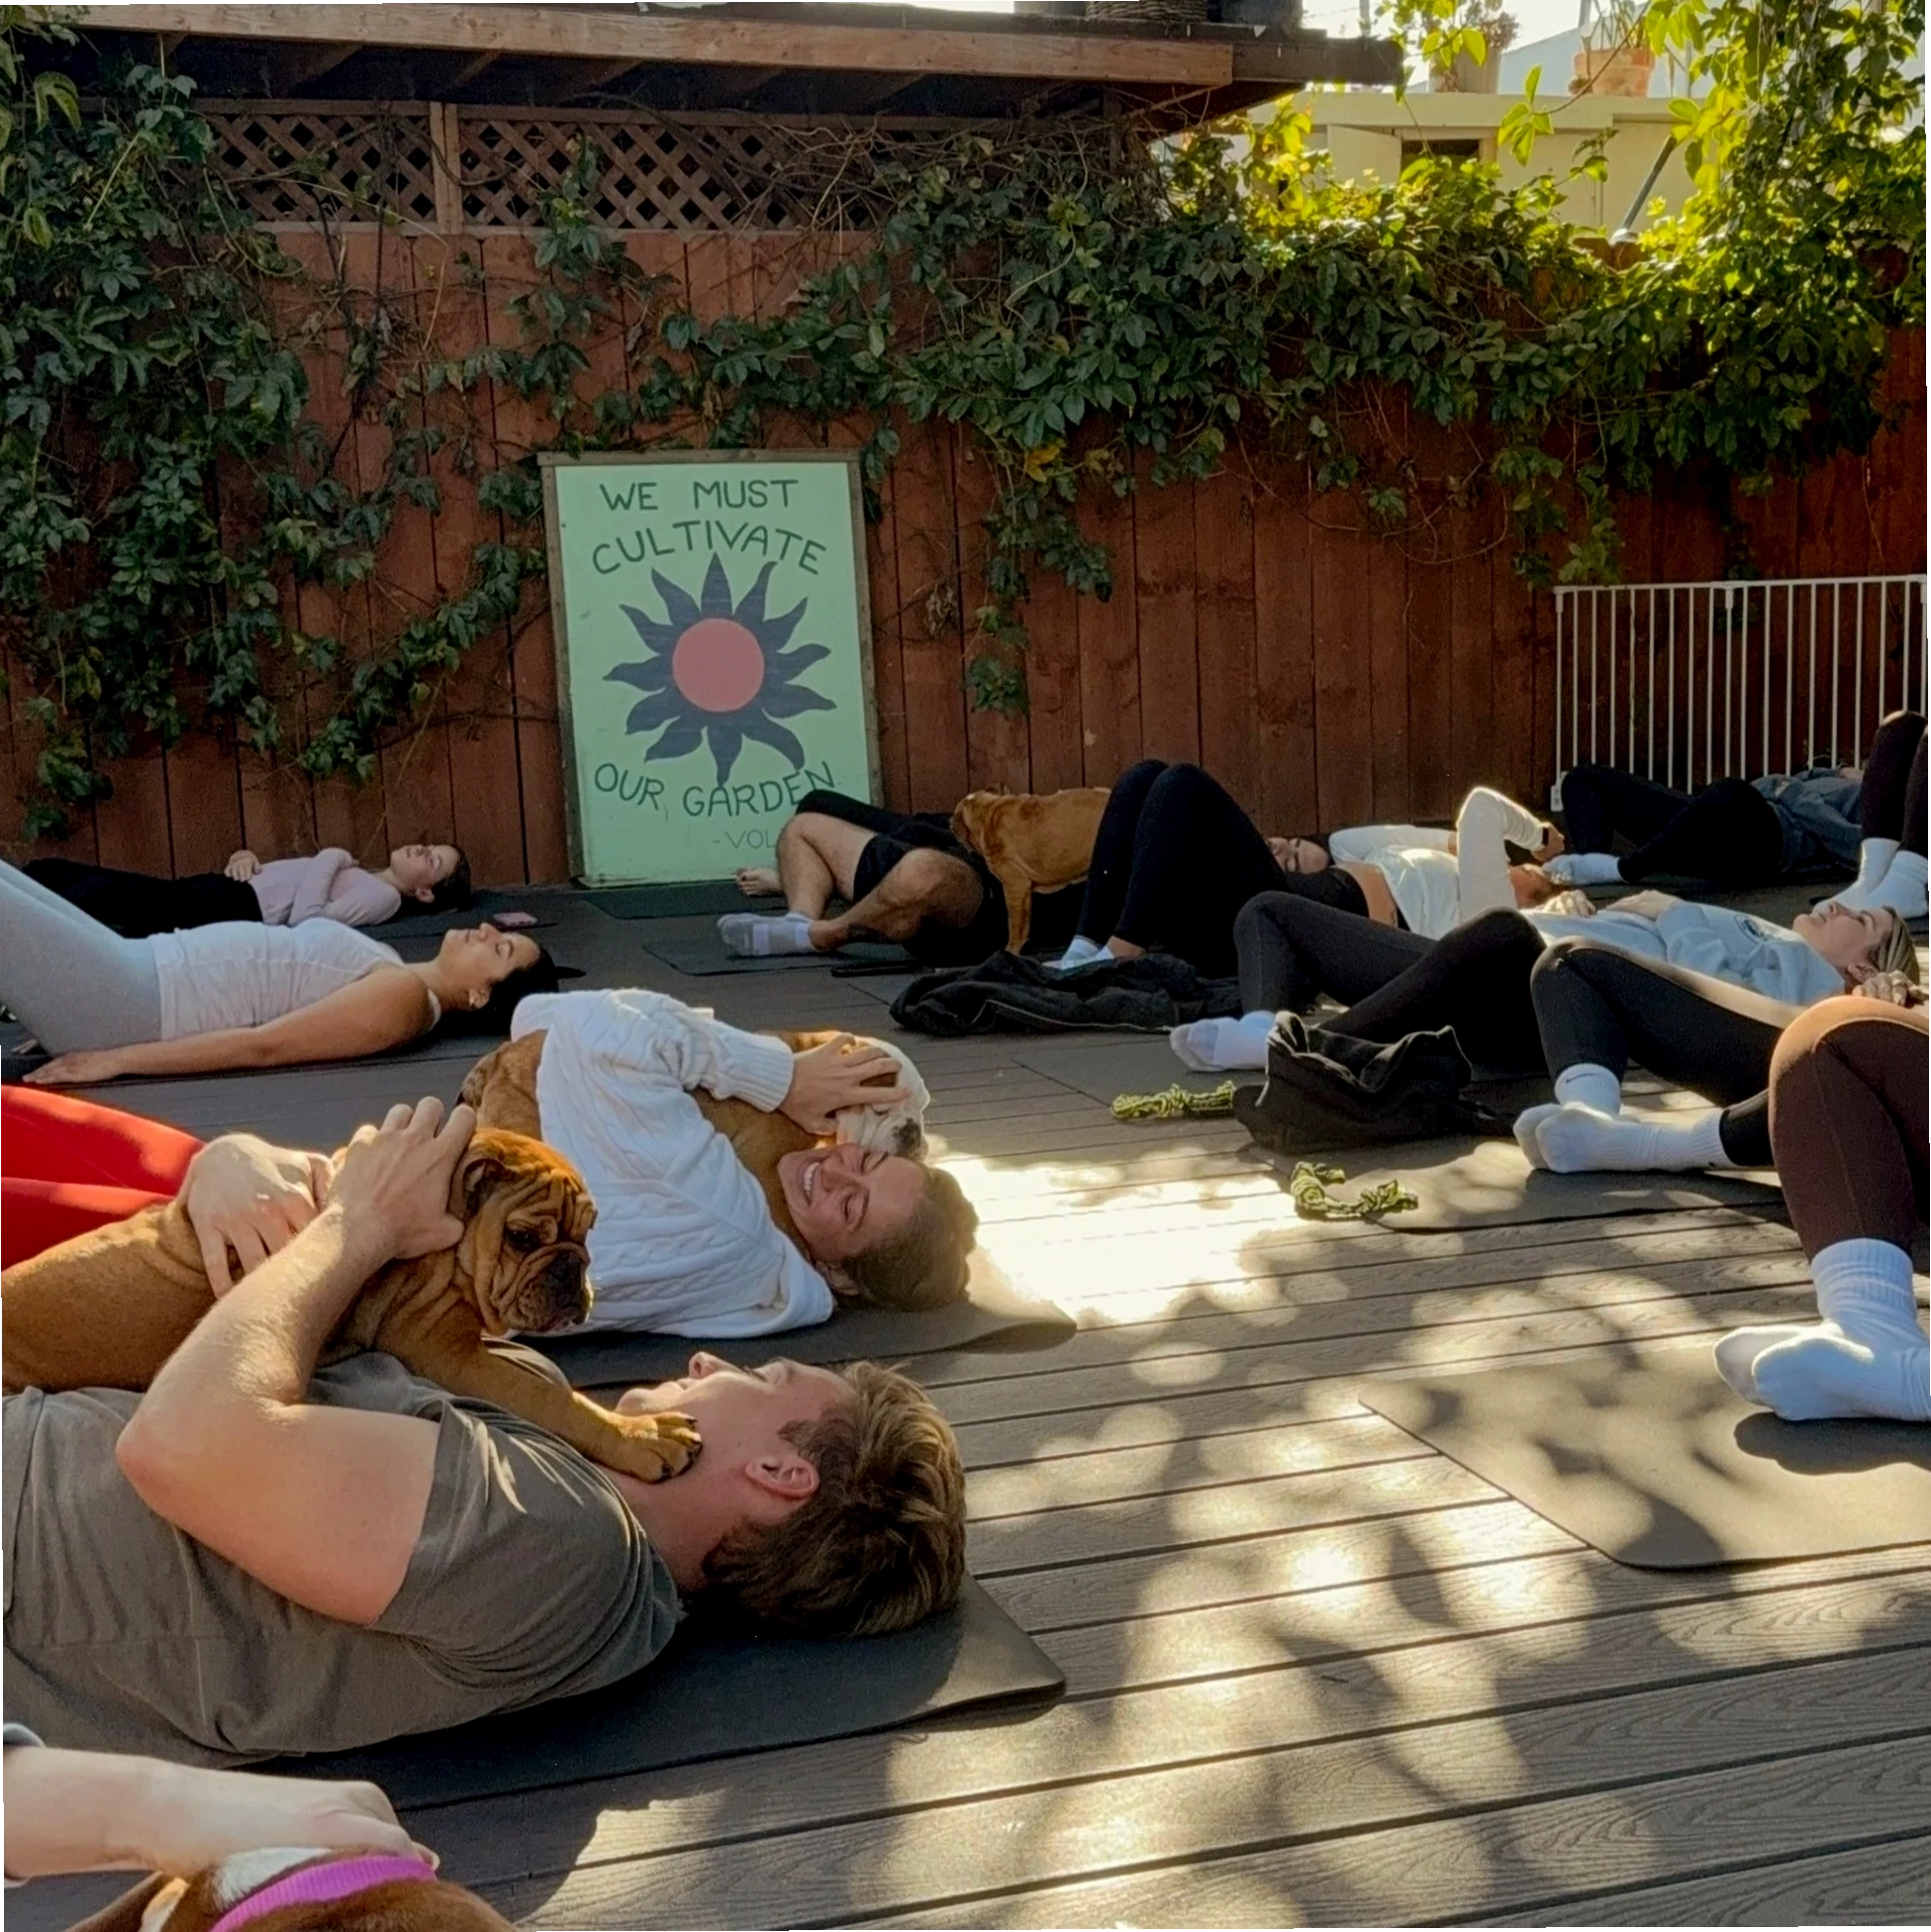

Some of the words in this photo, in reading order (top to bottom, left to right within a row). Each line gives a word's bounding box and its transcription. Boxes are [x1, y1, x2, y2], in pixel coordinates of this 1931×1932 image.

[599, 481, 659, 512] WE
[693, 479, 799, 510] MUST
[592, 520, 827, 576] CULTIVATE
[594, 762, 665, 812] OUR
[683, 760, 835, 818] GARDEN
